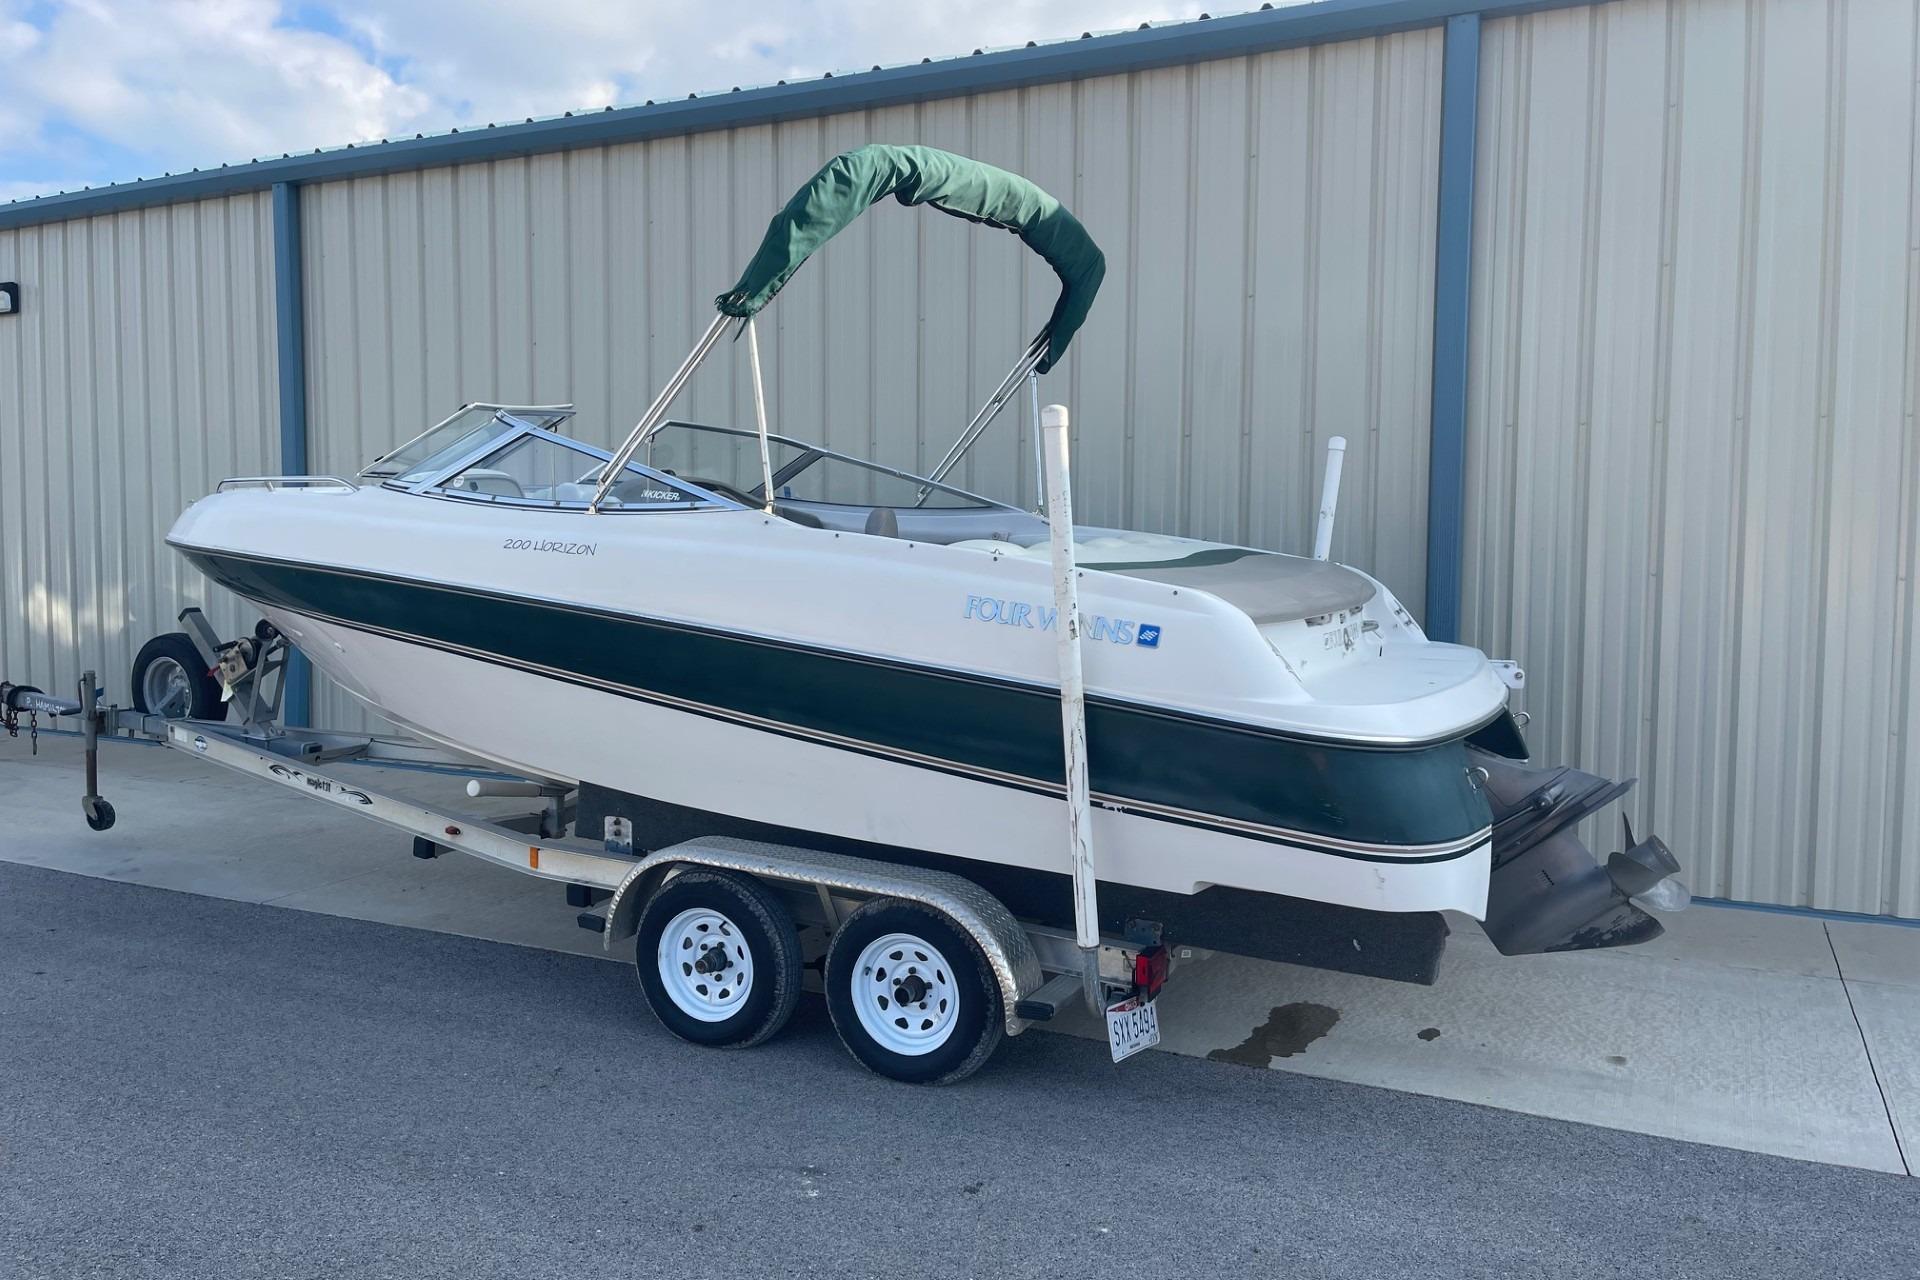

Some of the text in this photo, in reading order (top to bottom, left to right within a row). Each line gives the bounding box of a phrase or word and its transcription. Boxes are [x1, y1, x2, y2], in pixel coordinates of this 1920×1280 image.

[503, 538, 598, 556] 200 HORIZON
[963, 595, 1135, 645] FOUR WNNS
[1113, 1006, 1156, 1047] SXX 5494
